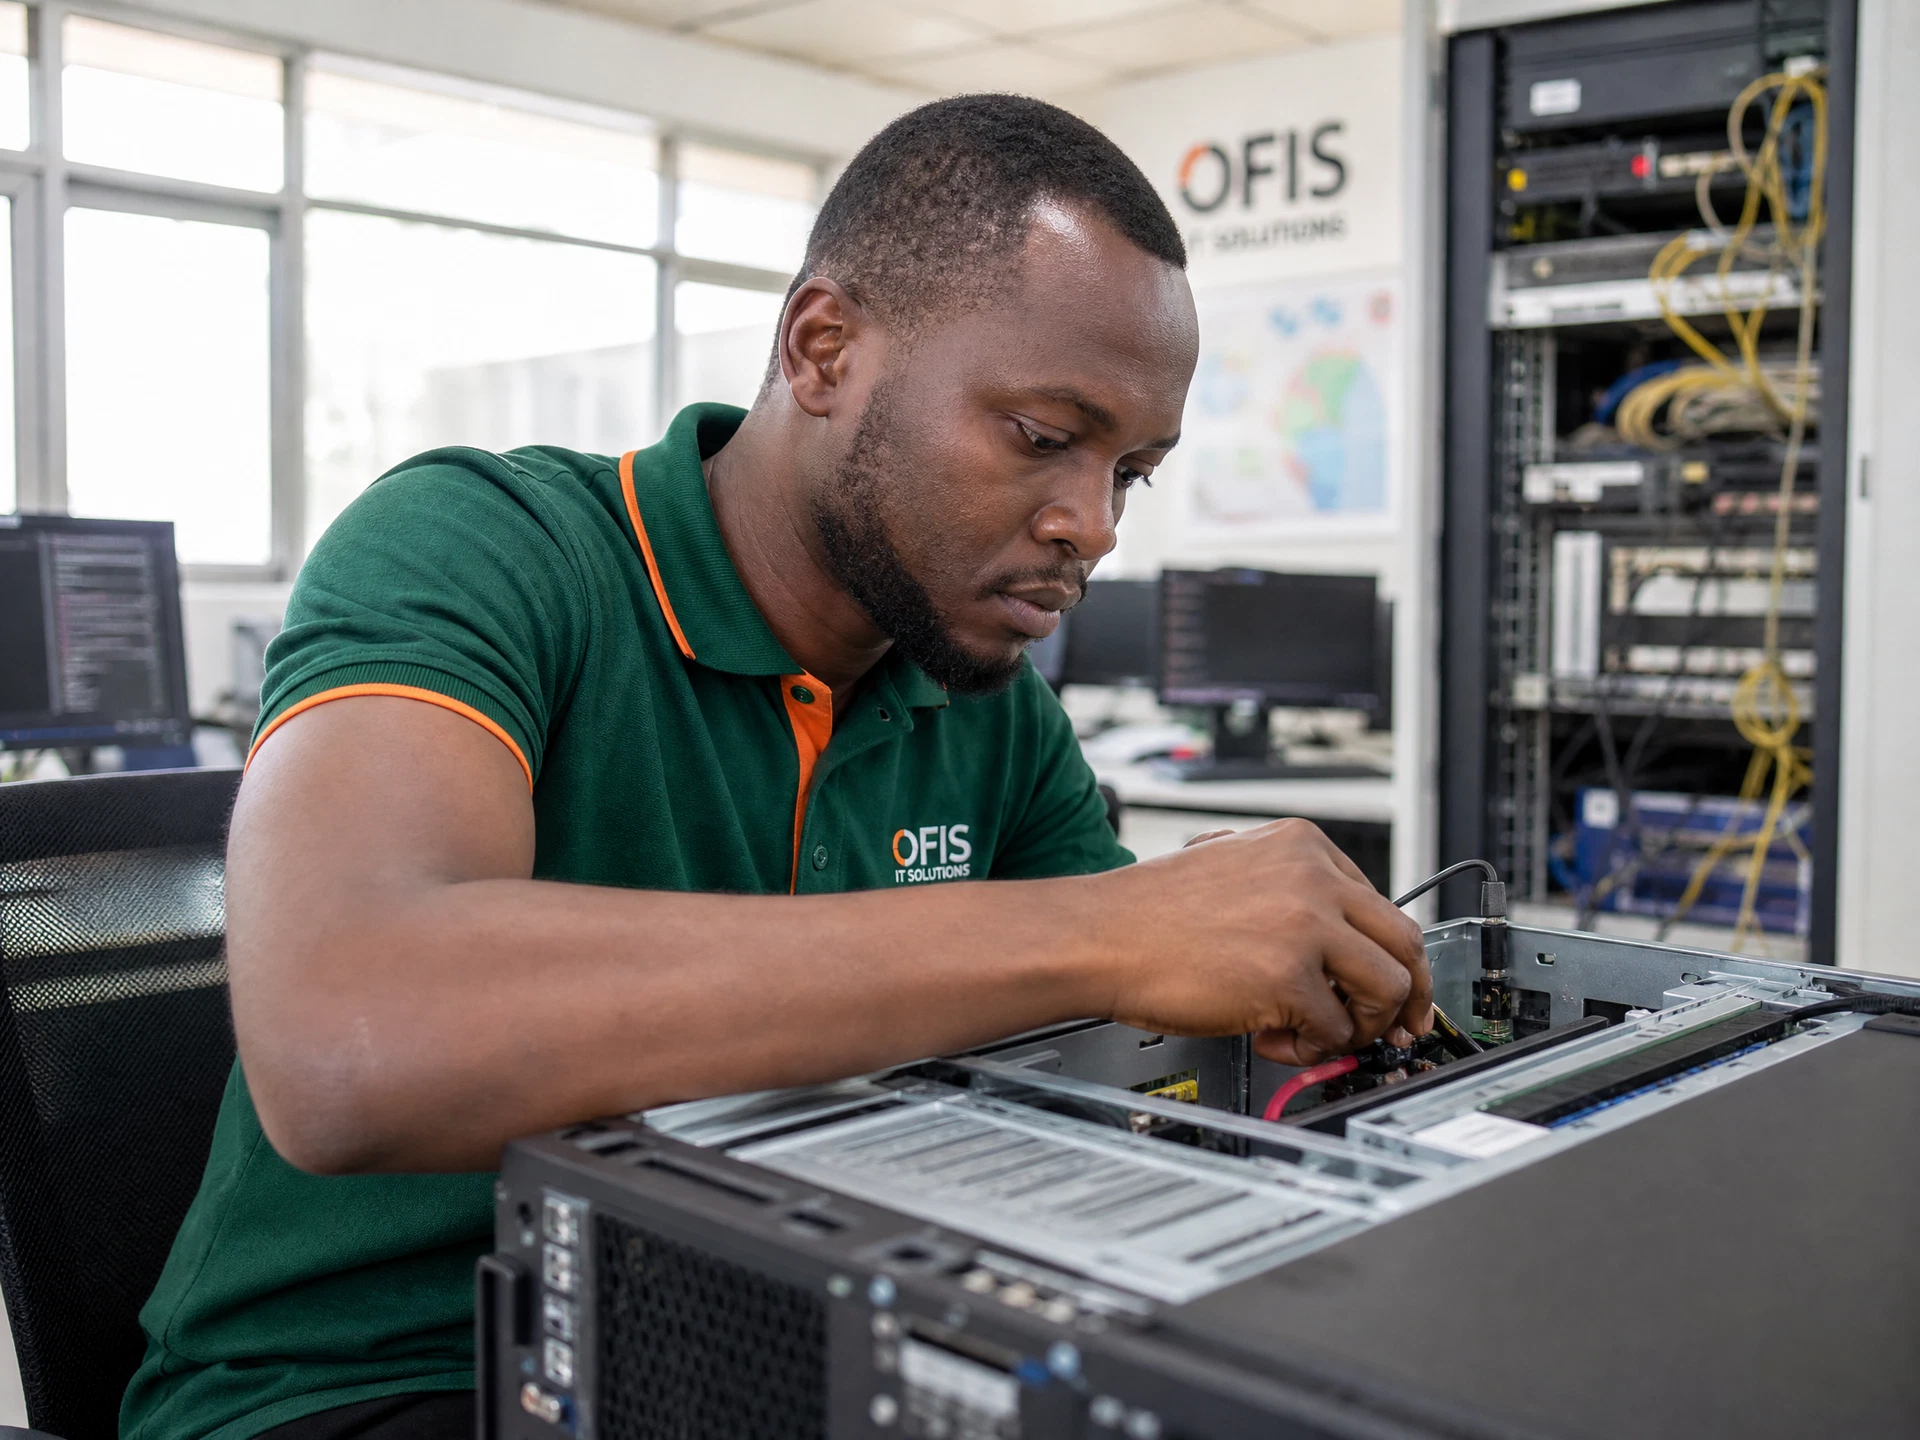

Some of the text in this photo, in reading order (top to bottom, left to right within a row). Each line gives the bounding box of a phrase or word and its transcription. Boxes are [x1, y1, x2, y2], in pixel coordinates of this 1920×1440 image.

[1177, 120, 1348, 214] OFIS
[892, 824, 972, 867] OFIS
[895, 863, 971, 883] IT SOLUTIONS
